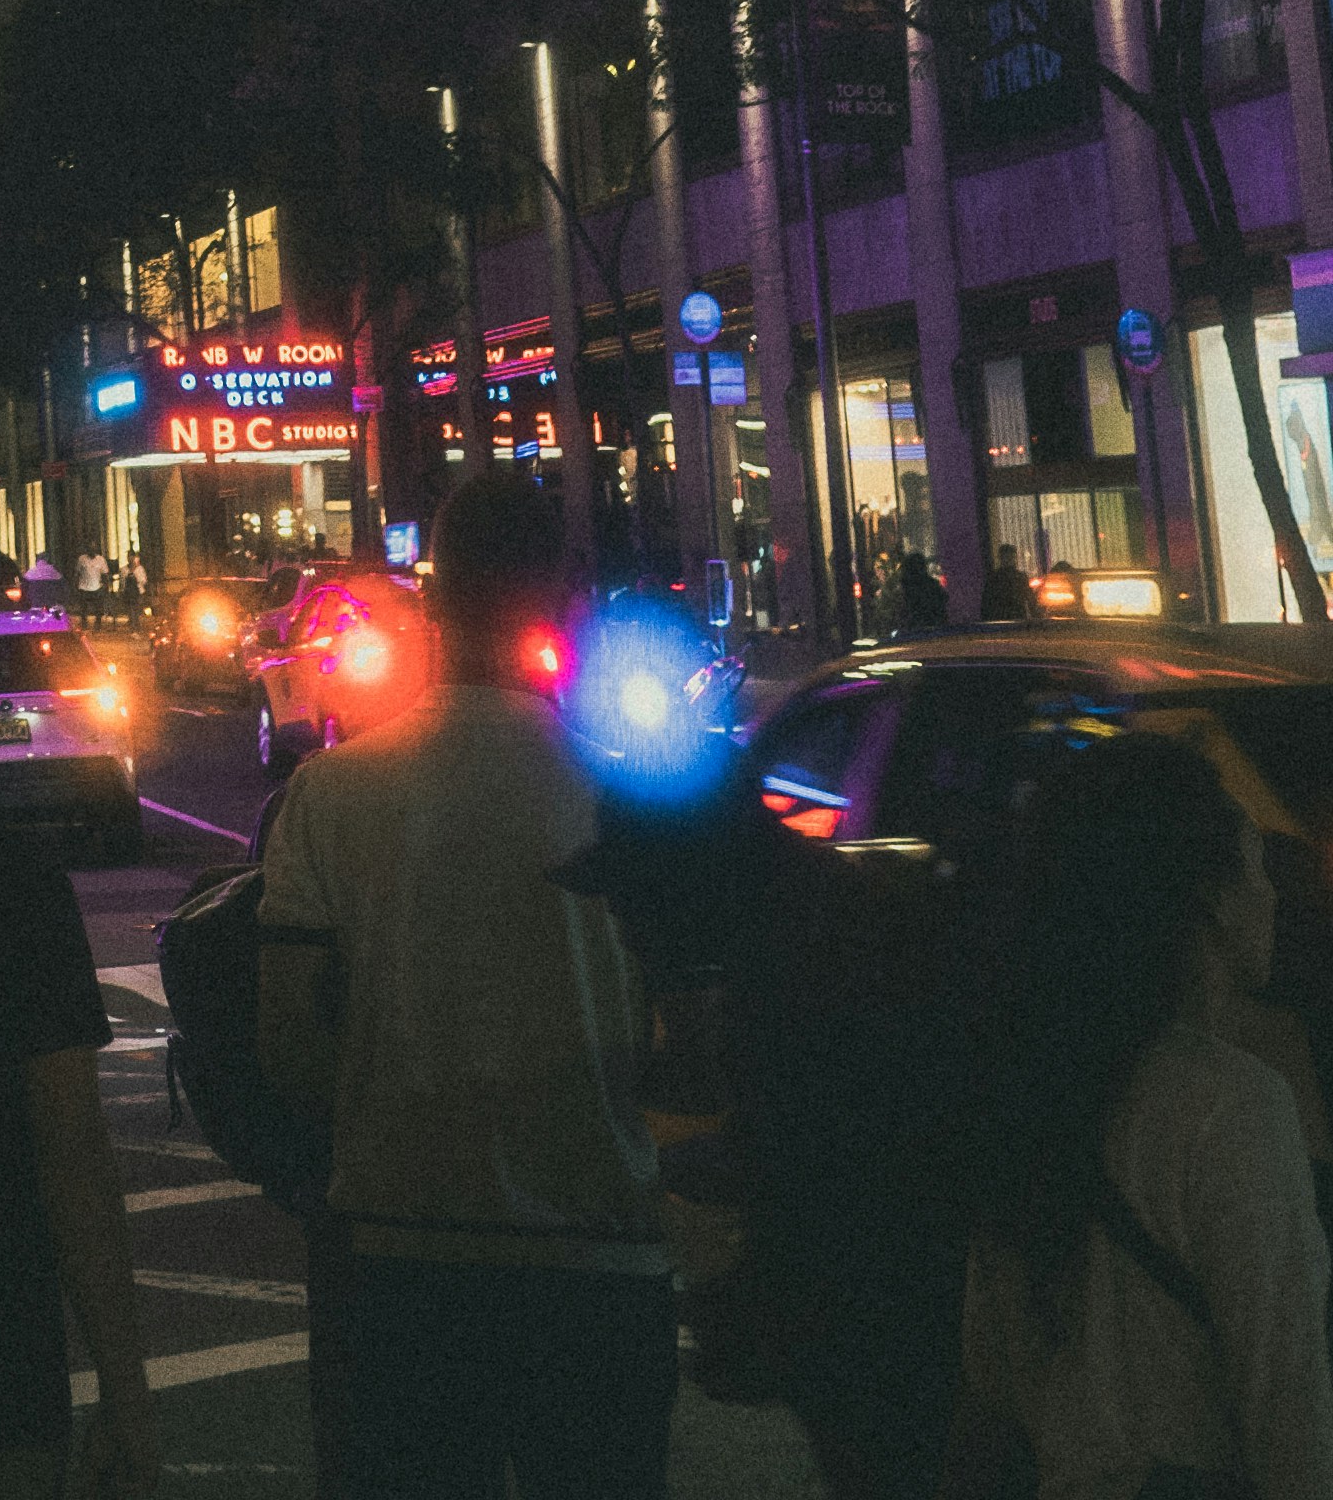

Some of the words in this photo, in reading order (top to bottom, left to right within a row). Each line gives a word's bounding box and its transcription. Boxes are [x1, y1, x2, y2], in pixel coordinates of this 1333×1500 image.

[180, 370, 333, 391] OSERVATION
[226, 389, 284, 408] DECK
[170, 417, 274, 452] NBC
